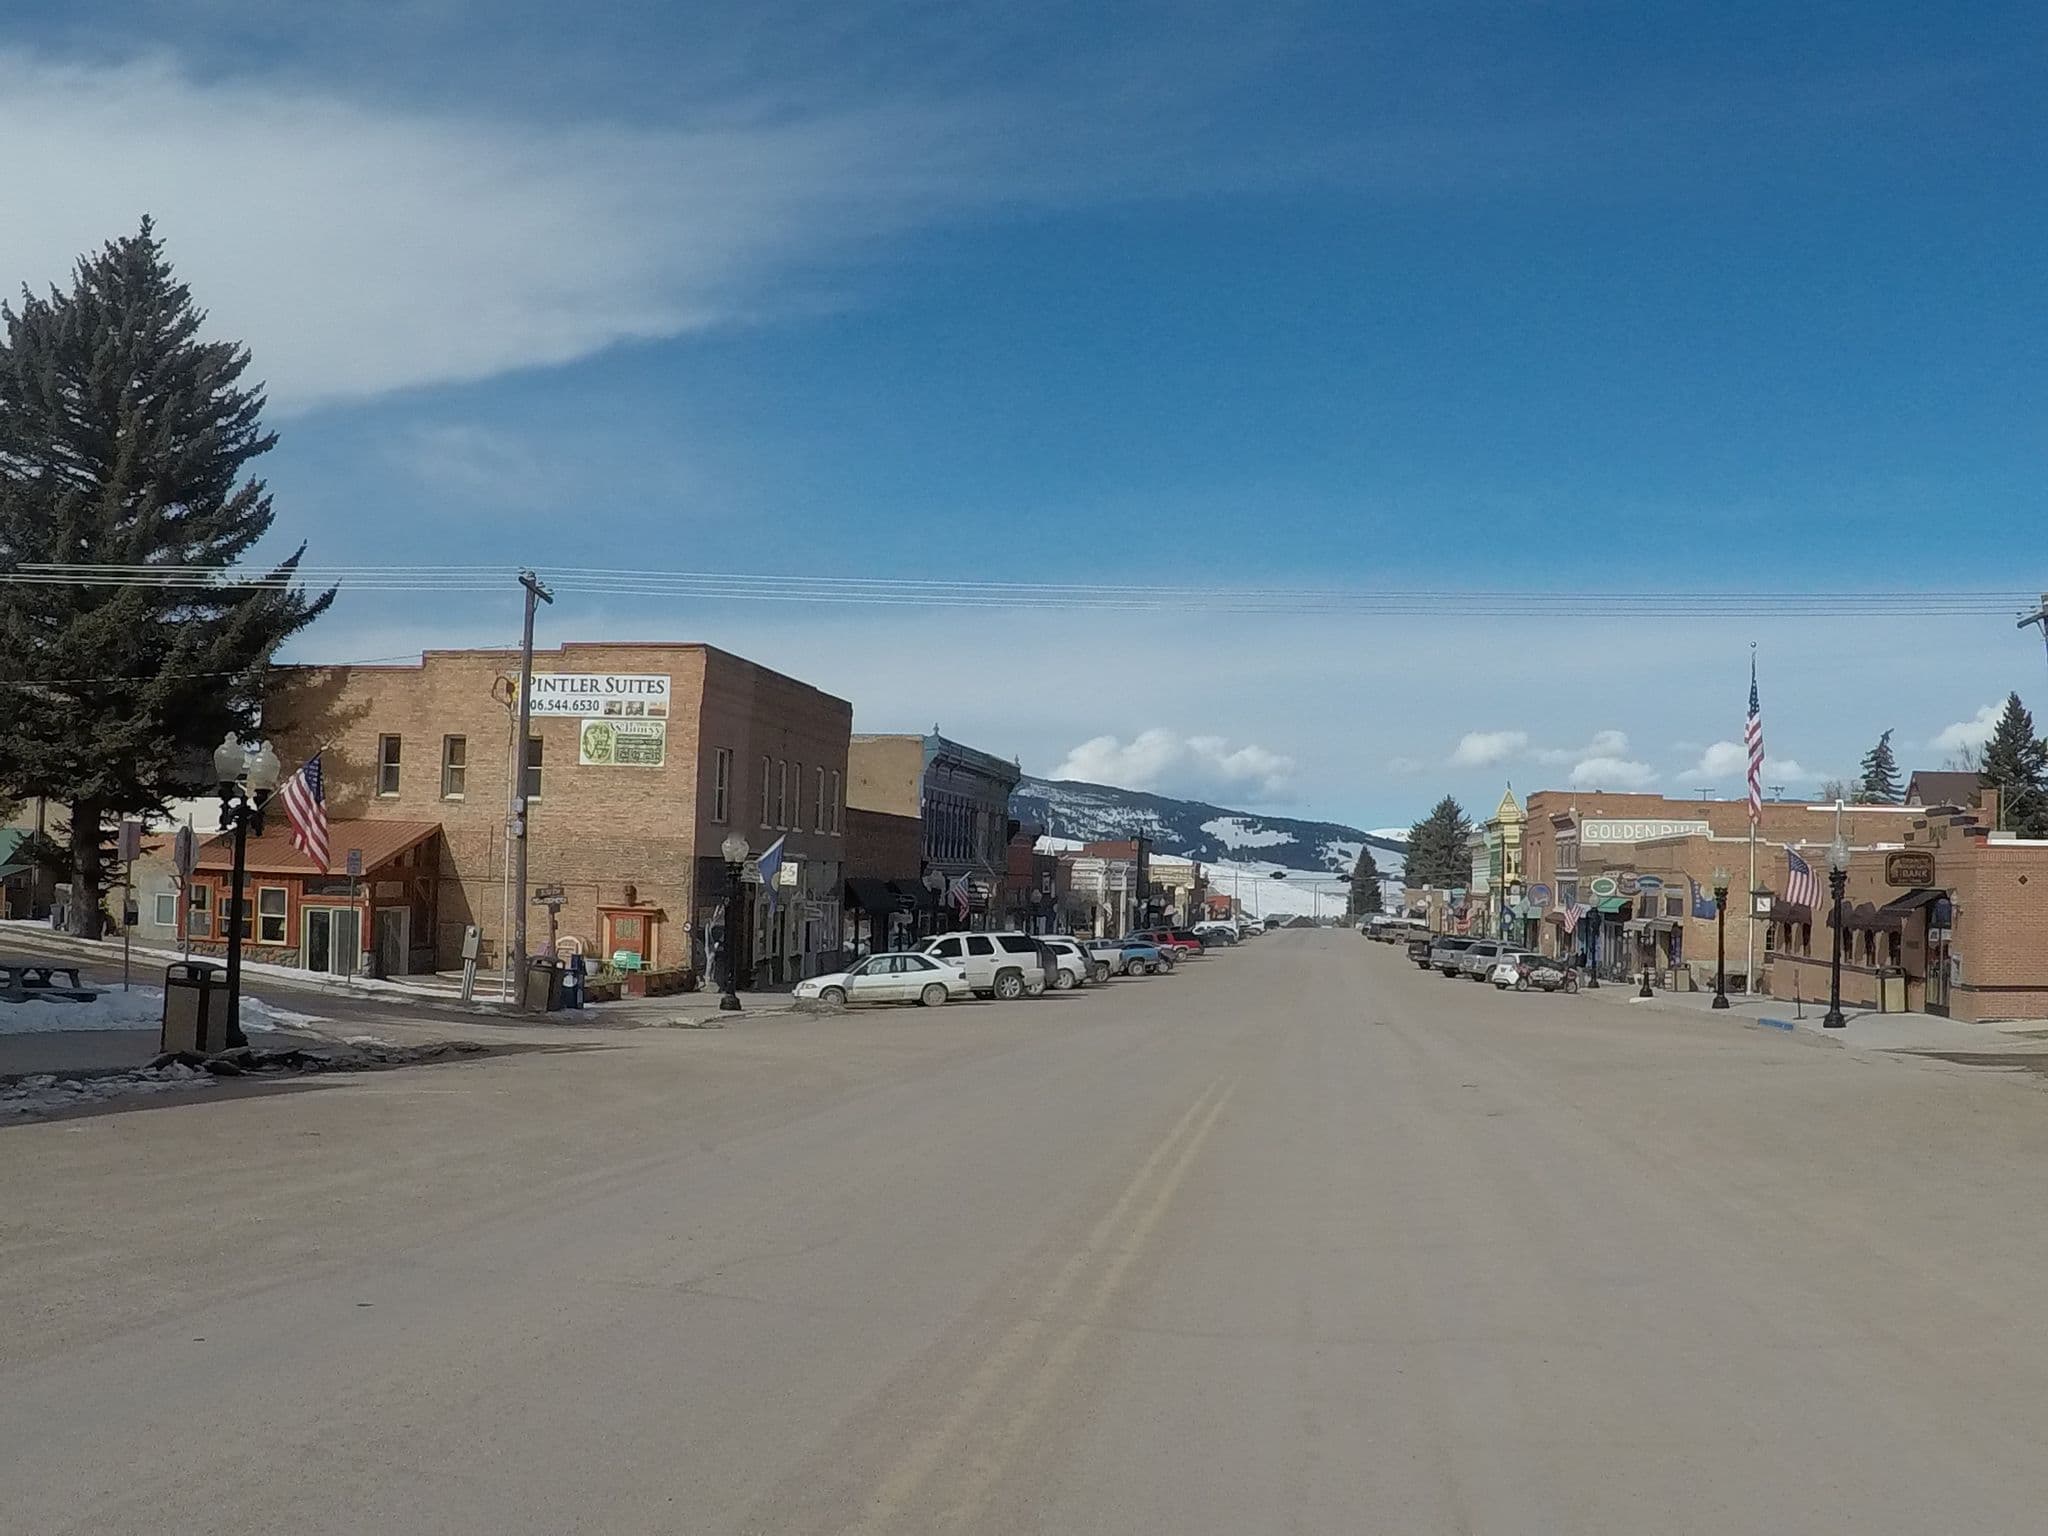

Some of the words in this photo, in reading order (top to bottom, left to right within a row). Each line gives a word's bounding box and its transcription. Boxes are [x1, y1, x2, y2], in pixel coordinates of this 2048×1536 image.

[605, 676, 665, 694] SUITES
[530, 699, 600, 711] 06.544.6530
[1585, 824, 1656, 839] GOLDEN
